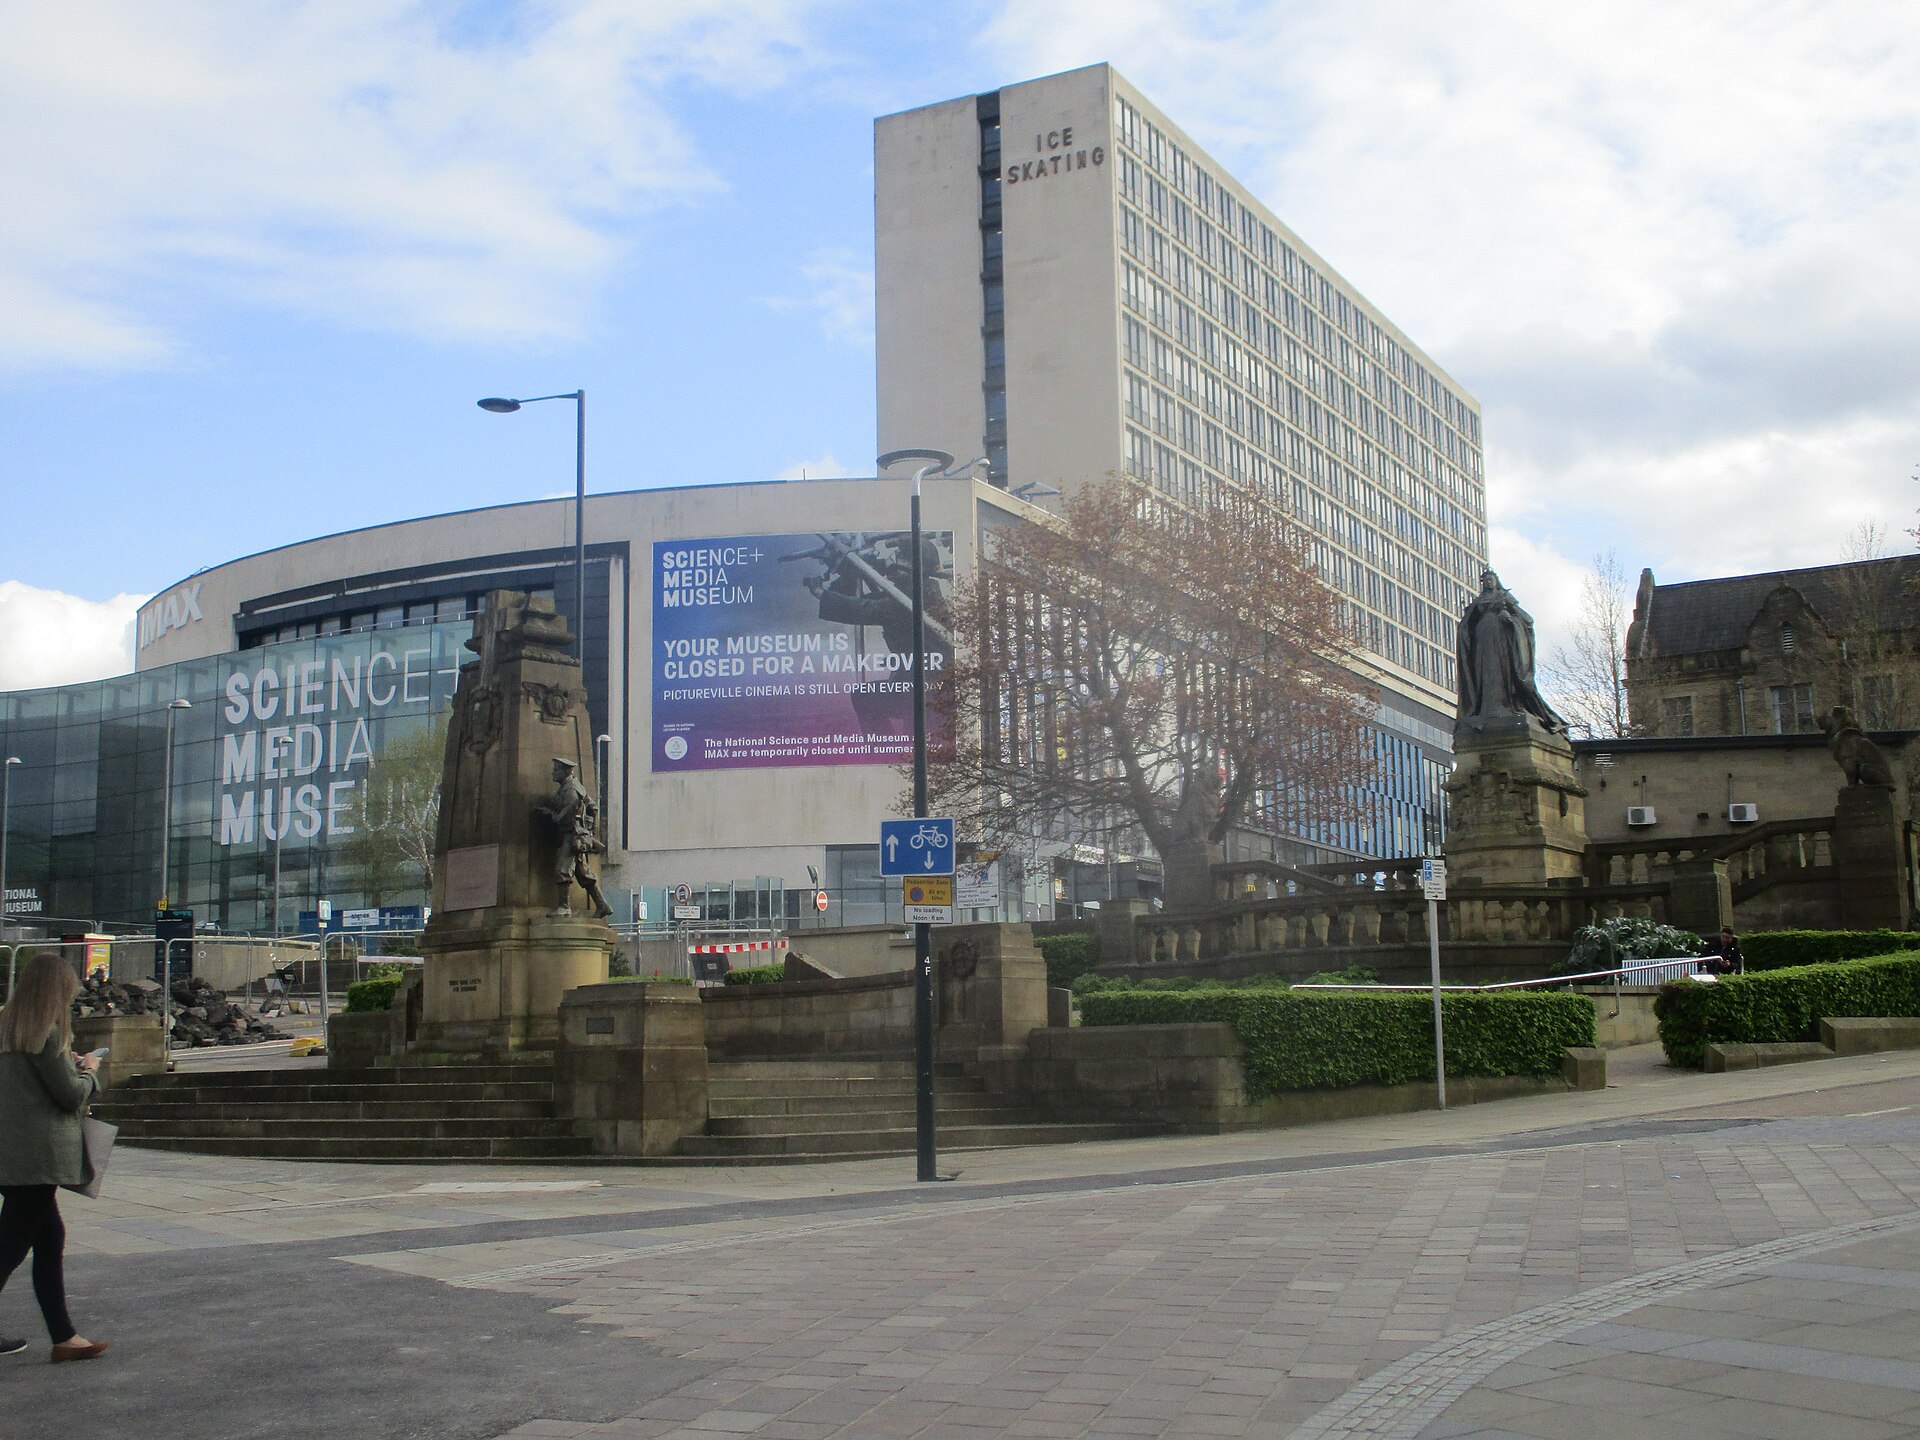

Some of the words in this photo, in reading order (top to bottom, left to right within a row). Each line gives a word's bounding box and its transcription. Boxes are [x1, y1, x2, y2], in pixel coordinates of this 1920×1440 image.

[1037, 127, 1073, 152] ICE
[1007, 146, 1104, 184] SKATING
[662, 547, 764, 569] SCIENCE+
[663, 567, 729, 588] MEDIA
[663, 586, 754, 607] MUSEUM
[141, 583, 202, 648] IMAX
[663, 638, 719, 658] YOUR
[727, 634, 821, 655] MUSEUM
[829, 633, 849, 651] IS
[663, 658, 745, 679] CLOSED
[753, 656, 794, 675] FOR
[801, 655, 815, 673] A
[663, 686, 742, 701] PICTUREVILLE
[745, 685, 791, 697] CINEMA
[794, 684, 805, 696] IS
[809, 683, 840, 695] STILL
[843, 682, 876, 694] OPEN
[222, 717, 375, 785] MEDIA
[704, 738, 722, 748] The
[725, 736, 766, 748] National
[769, 735, 809, 746] Science
[811, 734, 830, 745] and
[833, 733, 864, 744] Media
[867, 733, 909, 743] Museum
[704, 748, 729, 759] IMAX
[732, 749, 747, 758] are
[750, 746, 809, 759] temporarily
[811, 745, 845, 756] closed
[848, 744, 870, 755] until
[873, 744, 914, 754] summer
[924, 956, 930, 964] 4
[925, 966, 931, 976] F
